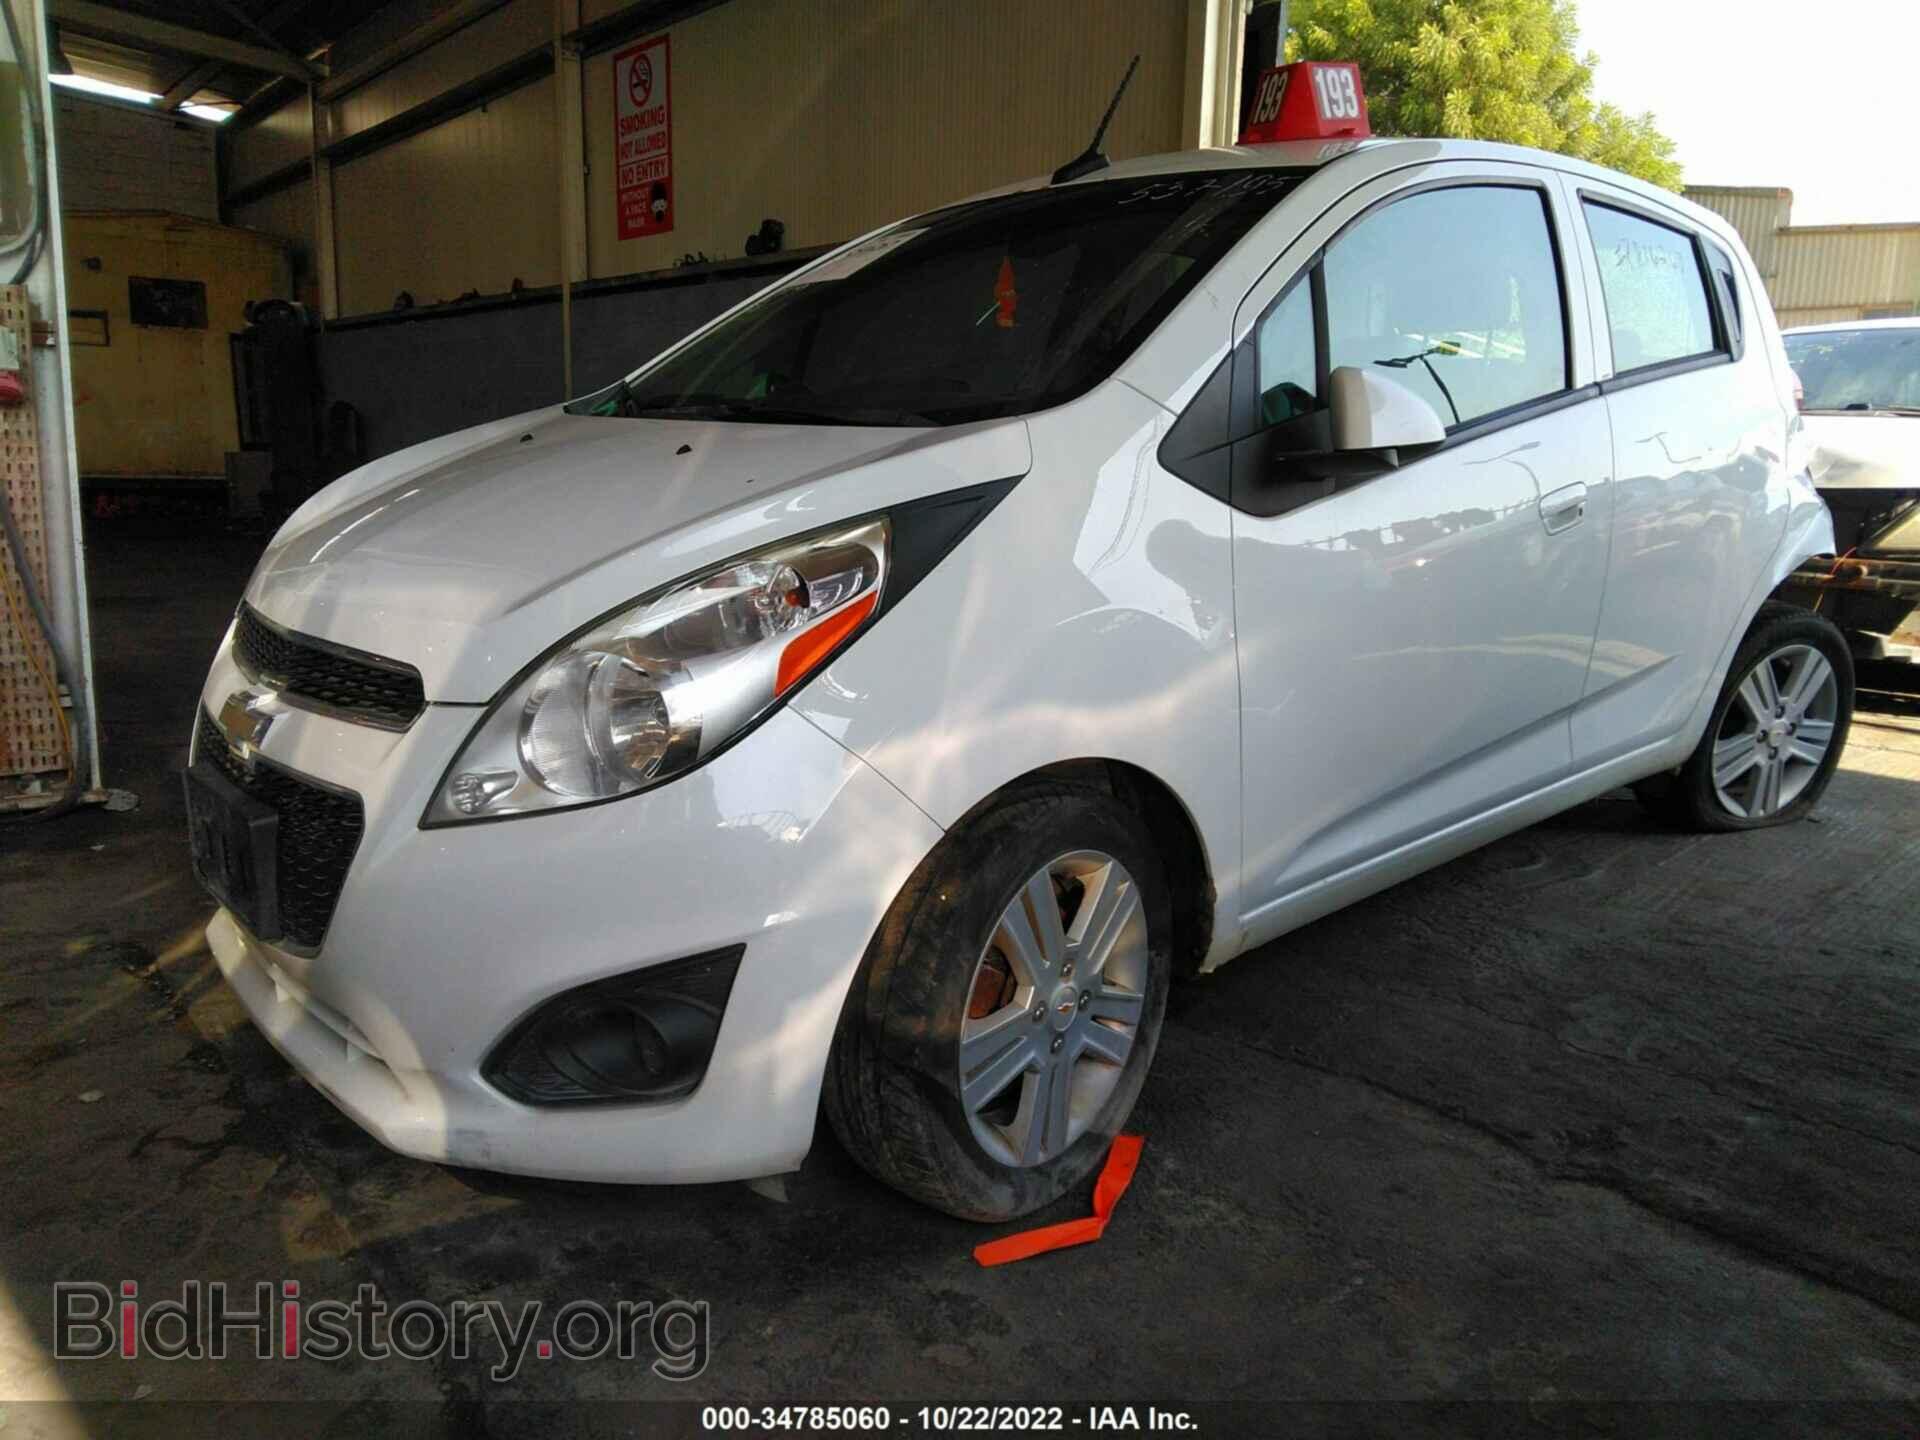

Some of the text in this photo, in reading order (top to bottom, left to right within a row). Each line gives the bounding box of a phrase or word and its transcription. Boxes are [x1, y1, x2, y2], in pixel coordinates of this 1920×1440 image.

[1253, 70, 1289, 125] 193
[1313, 67, 1360, 119] 193
[620, 107, 666, 137] SMOKING
[620, 131, 666, 160] NOT ALLOWED
[621, 160, 667, 185] NO ENTRY
